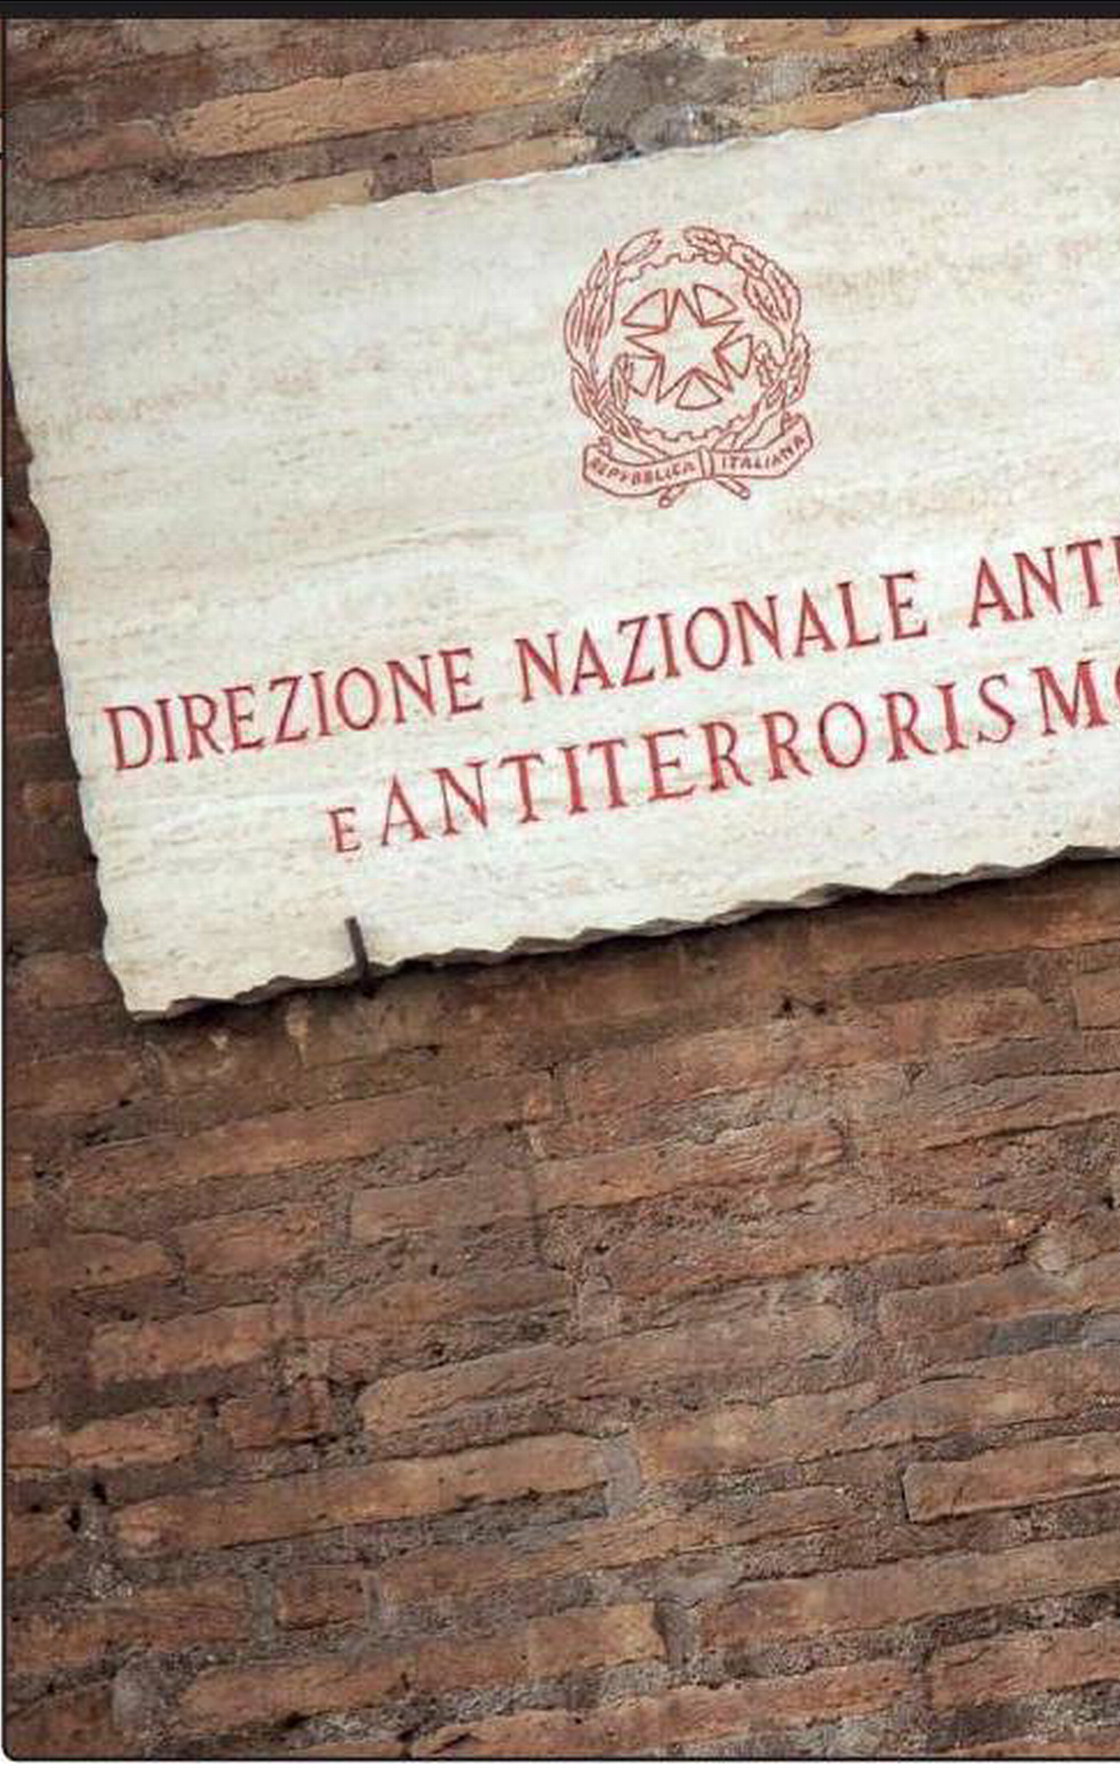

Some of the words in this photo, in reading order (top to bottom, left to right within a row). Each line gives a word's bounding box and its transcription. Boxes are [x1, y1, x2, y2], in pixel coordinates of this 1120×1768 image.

[722, 434, 806, 470] ITALIANA
[103, 647, 483, 770] DIREZIONE
[513, 571, 929, 702] NAZIONALE
[327, 805, 362, 854] E
